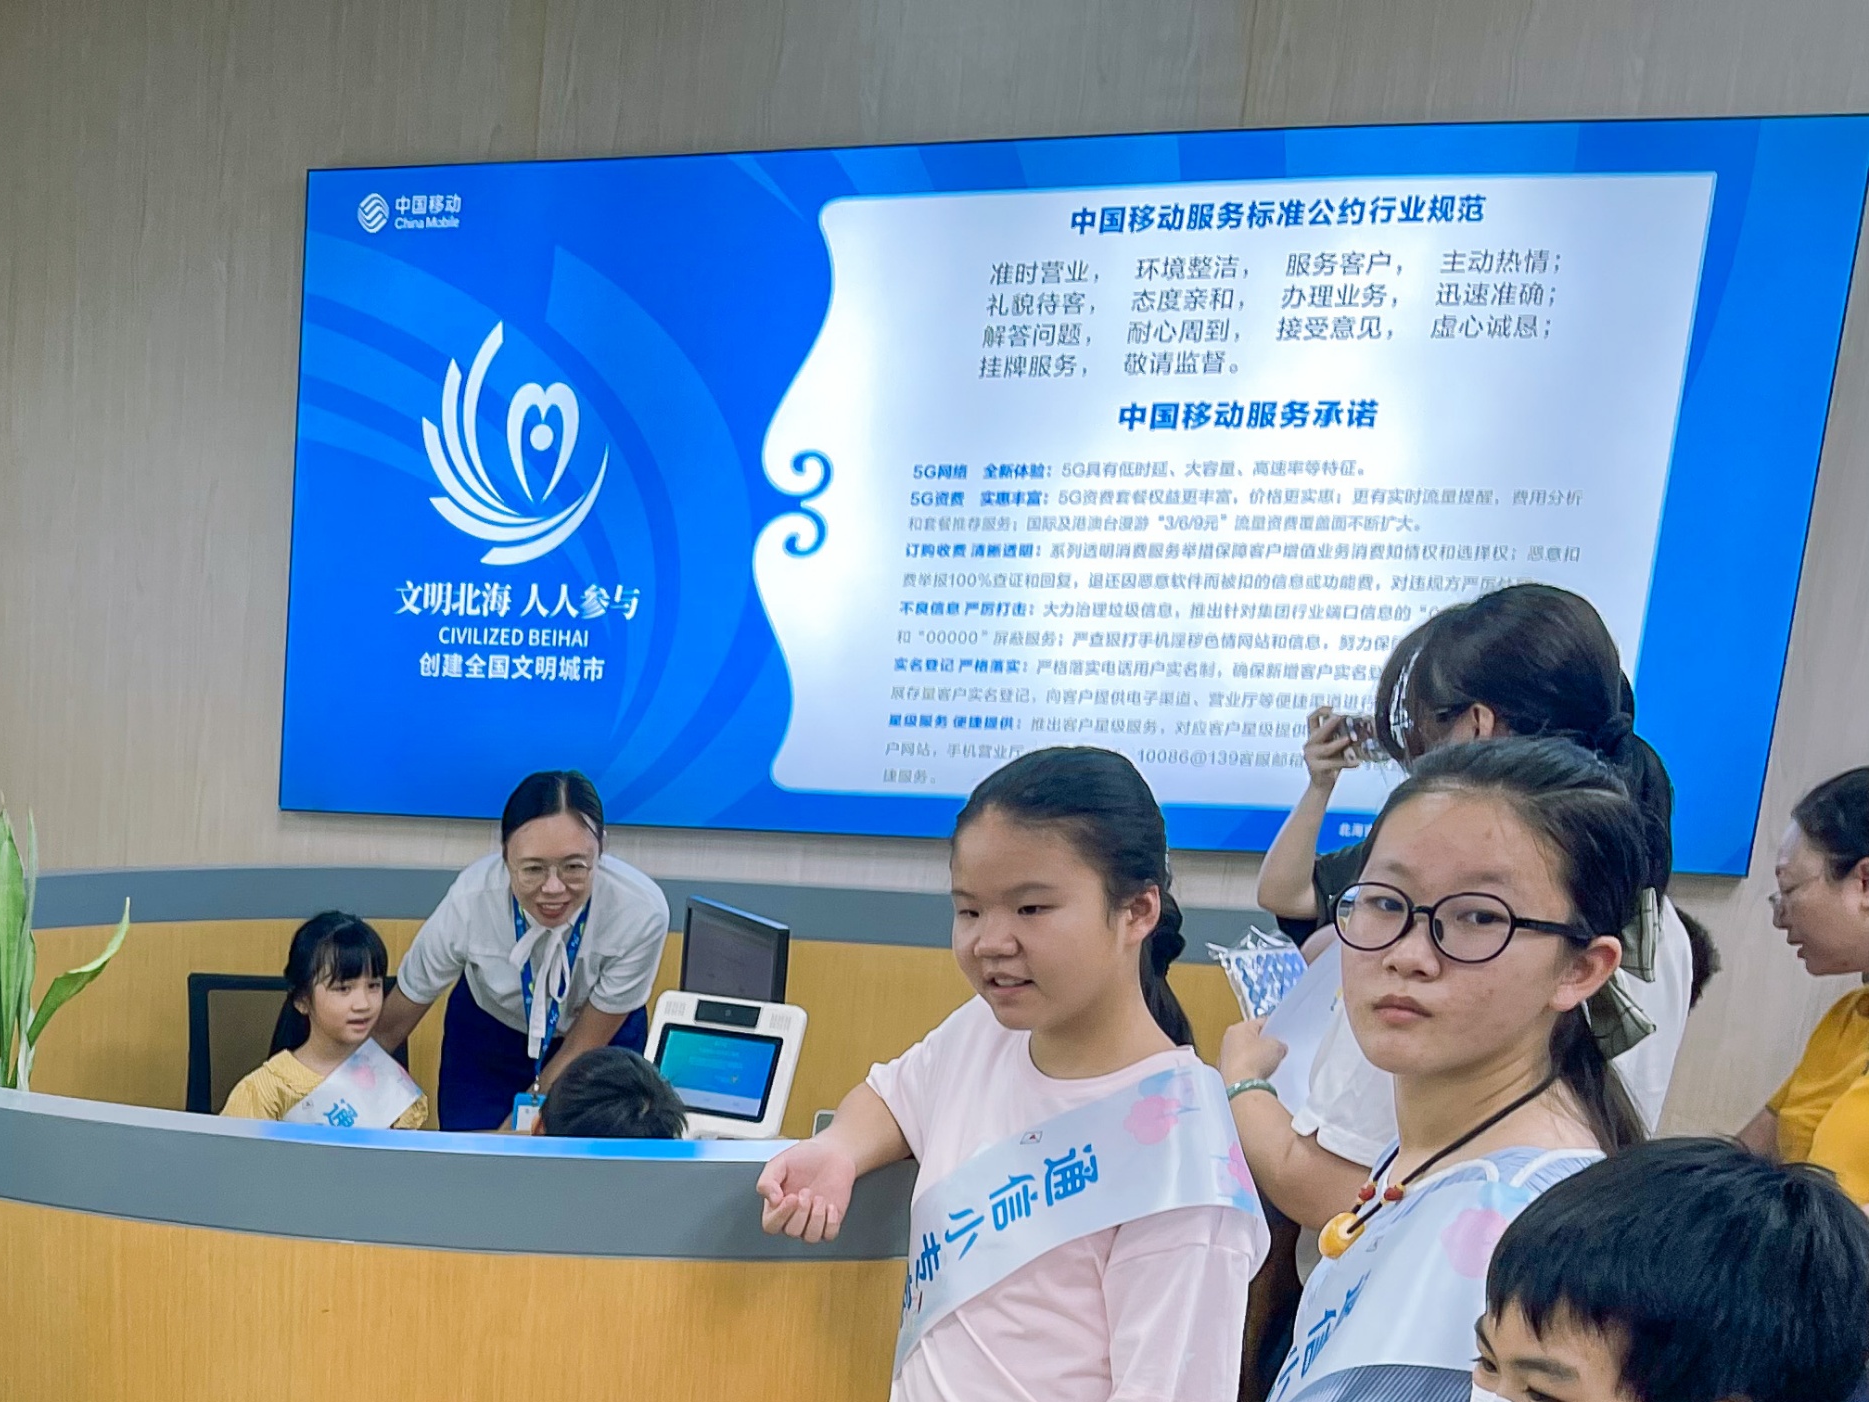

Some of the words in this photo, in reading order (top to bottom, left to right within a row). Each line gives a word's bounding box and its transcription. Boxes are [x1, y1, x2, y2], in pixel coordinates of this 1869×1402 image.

[394, 194, 462, 215] 中国移动
[1070, 194, 1487, 235] 中国移动服务标准公约行业规范
[394, 216, 425, 230] China
[426, 216, 460, 229] Mobile
[990, 258, 1100, 287] 准时营业，
[1134, 254, 1250, 282] 环境整洁，
[1285, 250, 1404, 278] 服务客户，
[986, 291, 1097, 318] 礼貌待客，
[1131, 287, 1245, 314] 态度亲和，
[1281, 284, 1399, 311] 办理业务，
[982, 322, 1093, 349] 解答问题，
[1127, 318, 1241, 345] 耐心周到，
[1276, 315, 1394, 343] 接受意见，
[978, 354, 1089, 380] 挂牌服务，
[1123, 350, 1238, 377] 敬请监督。
[1119, 398, 1380, 432] 中国移动服务承诺
[393, 581, 512, 618] 文明北海
[520, 583, 641, 620] 人人参与
[438, 626, 524, 646] CIVILIZED
[528, 628, 589, 647] BEIHAI
[419, 652, 606, 682] 创建全国文明城市
